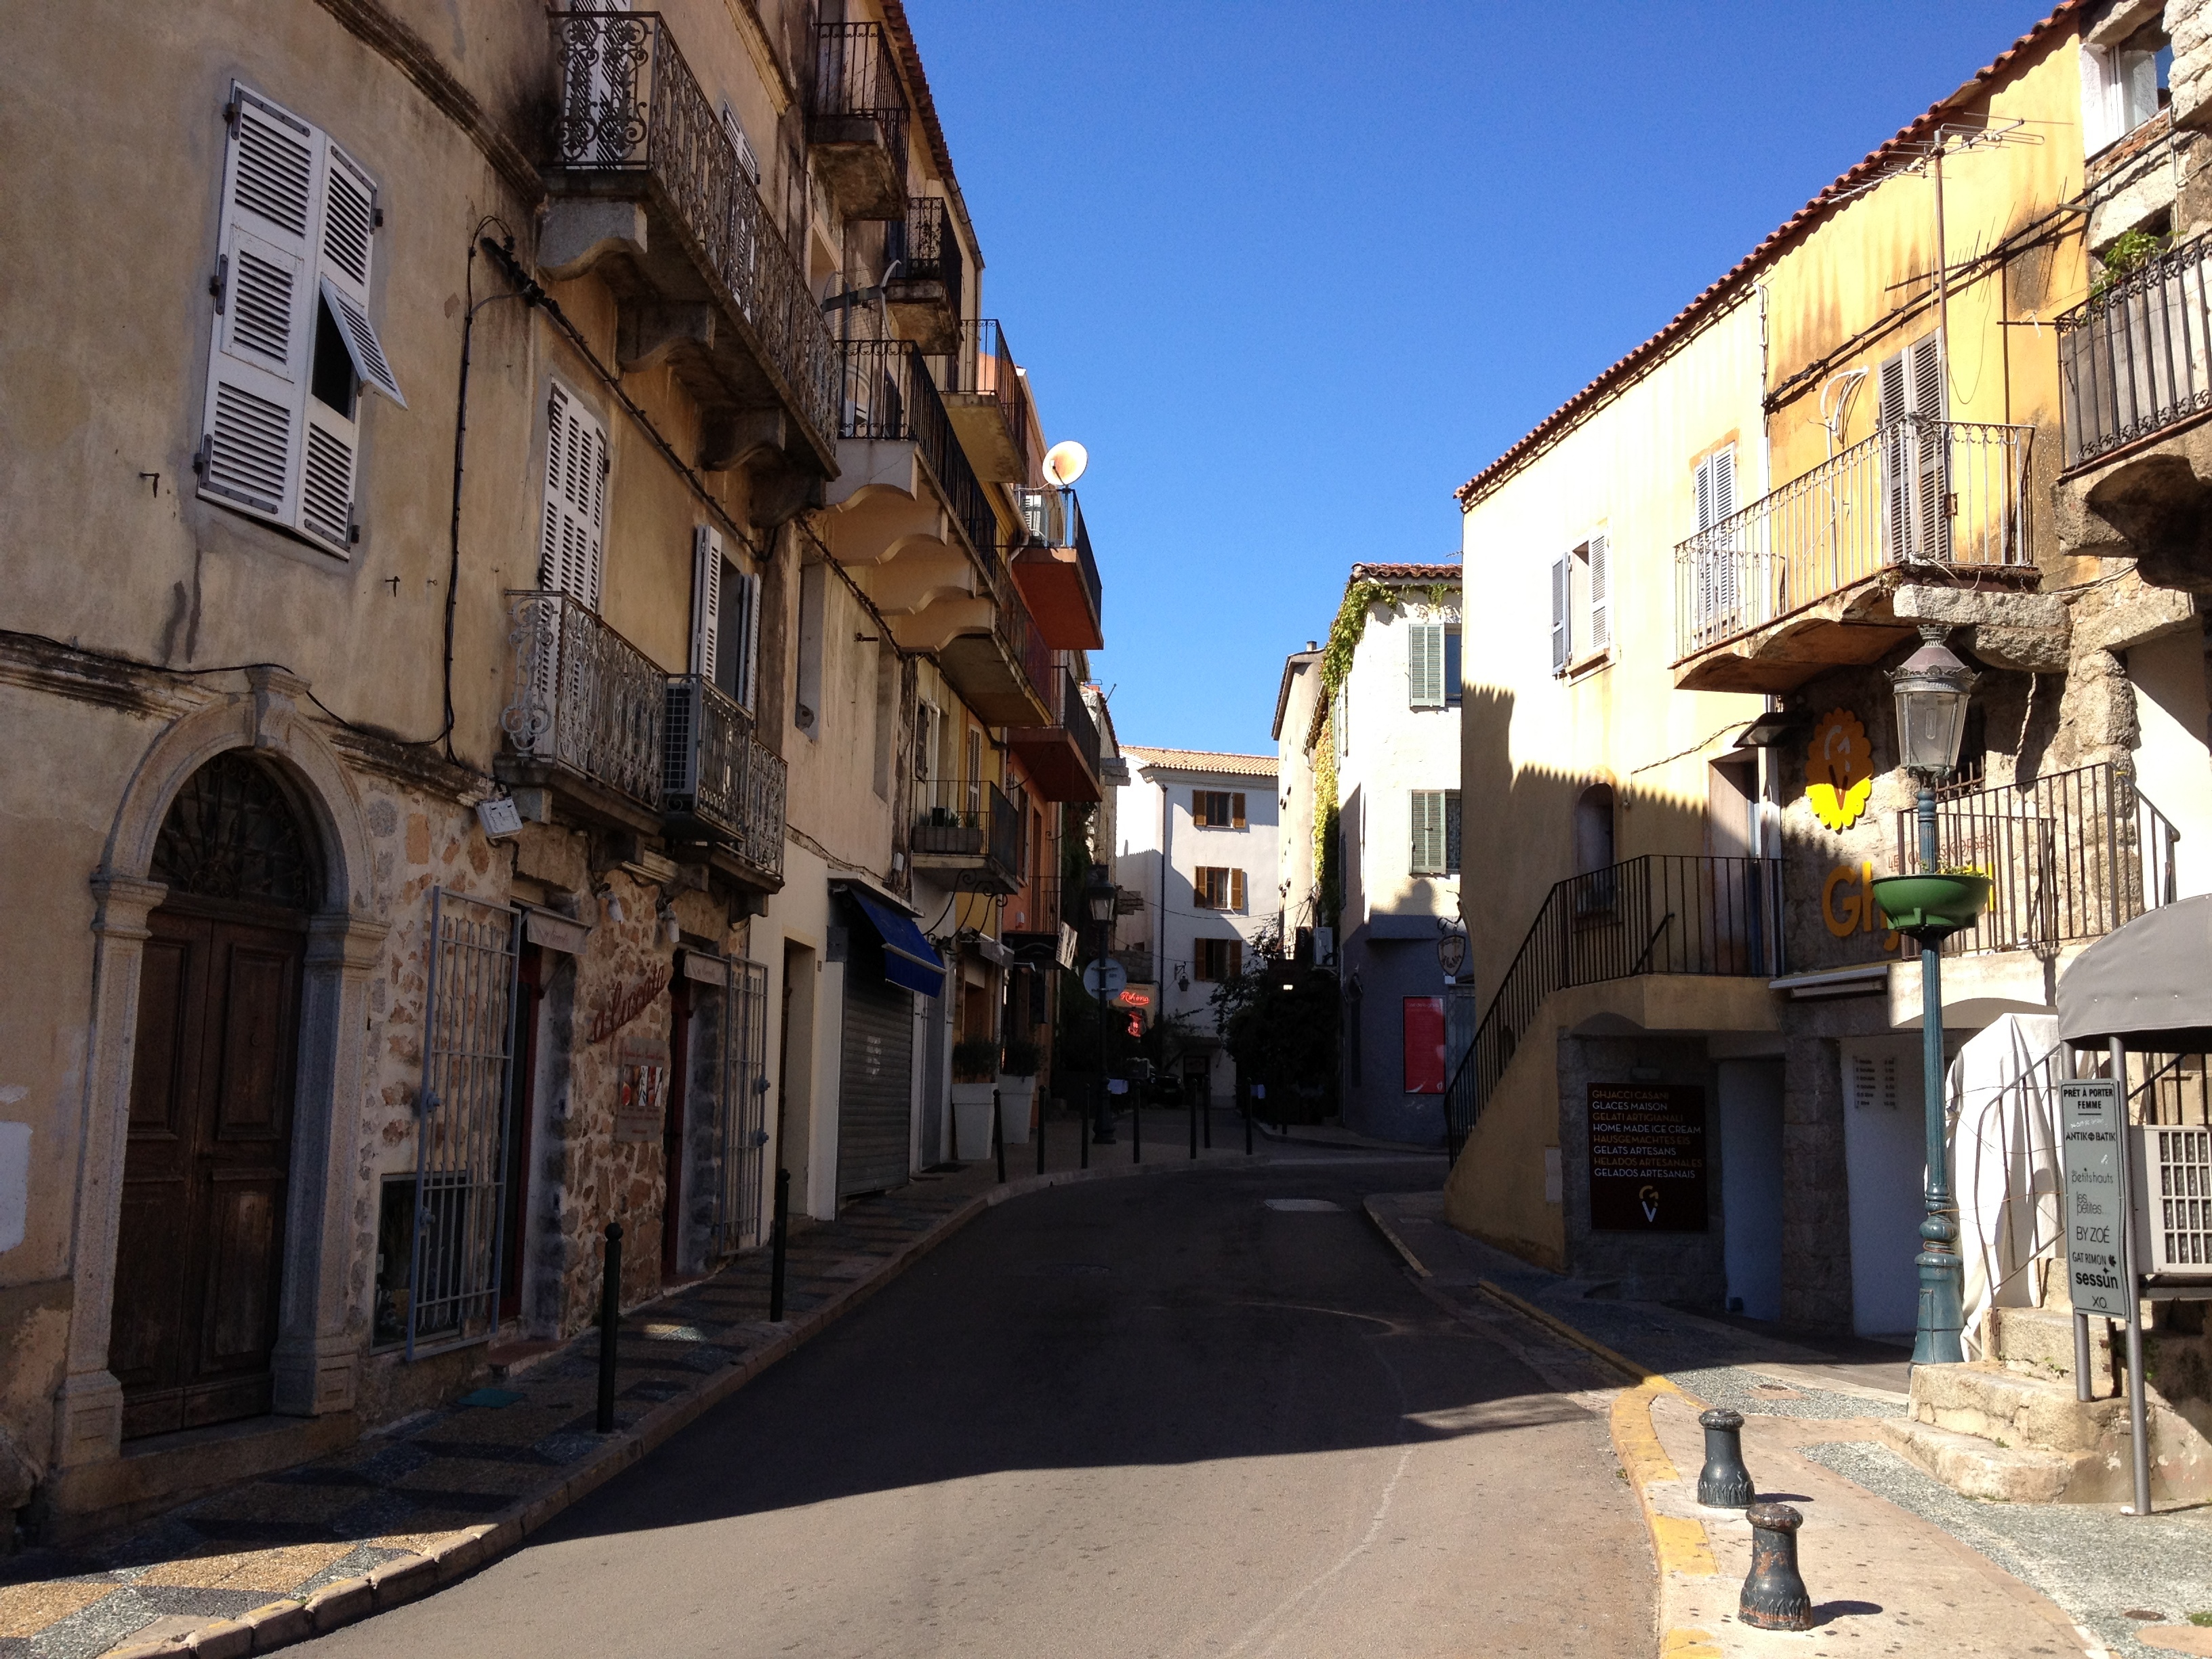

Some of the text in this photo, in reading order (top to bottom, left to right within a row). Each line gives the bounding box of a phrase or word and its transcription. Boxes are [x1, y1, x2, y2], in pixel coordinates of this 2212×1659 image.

[2064, 1087, 2113, 1097] PRÊT À PORTER
[1593, 1101, 1667, 1111] GLACES MAISON
[2078, 1101, 2102, 1109] FEMME
[1593, 1112, 1683, 1122] GELATI ARTIGIANALI
[1593, 1124, 1701, 1134] HOME MADE ICE CREAM
[1593, 1134, 1691, 1145] HAUSGEMACHTES EIS
[2066, 1132, 2116, 1141] ANTIK BATIK
[1594, 1146, 1677, 1155] GELATS ARTESANS
[1594, 1158, 1702, 1168] HELADOS ARTESANALES
[1595, 1168, 1696, 1179] GELADOS ARTESANAIS
[2076, 1191, 2087, 1204] les
[2076, 1225, 2110, 1243] BY ZOÉ
[2072, 1252, 2106, 1265] GAT RIMON
